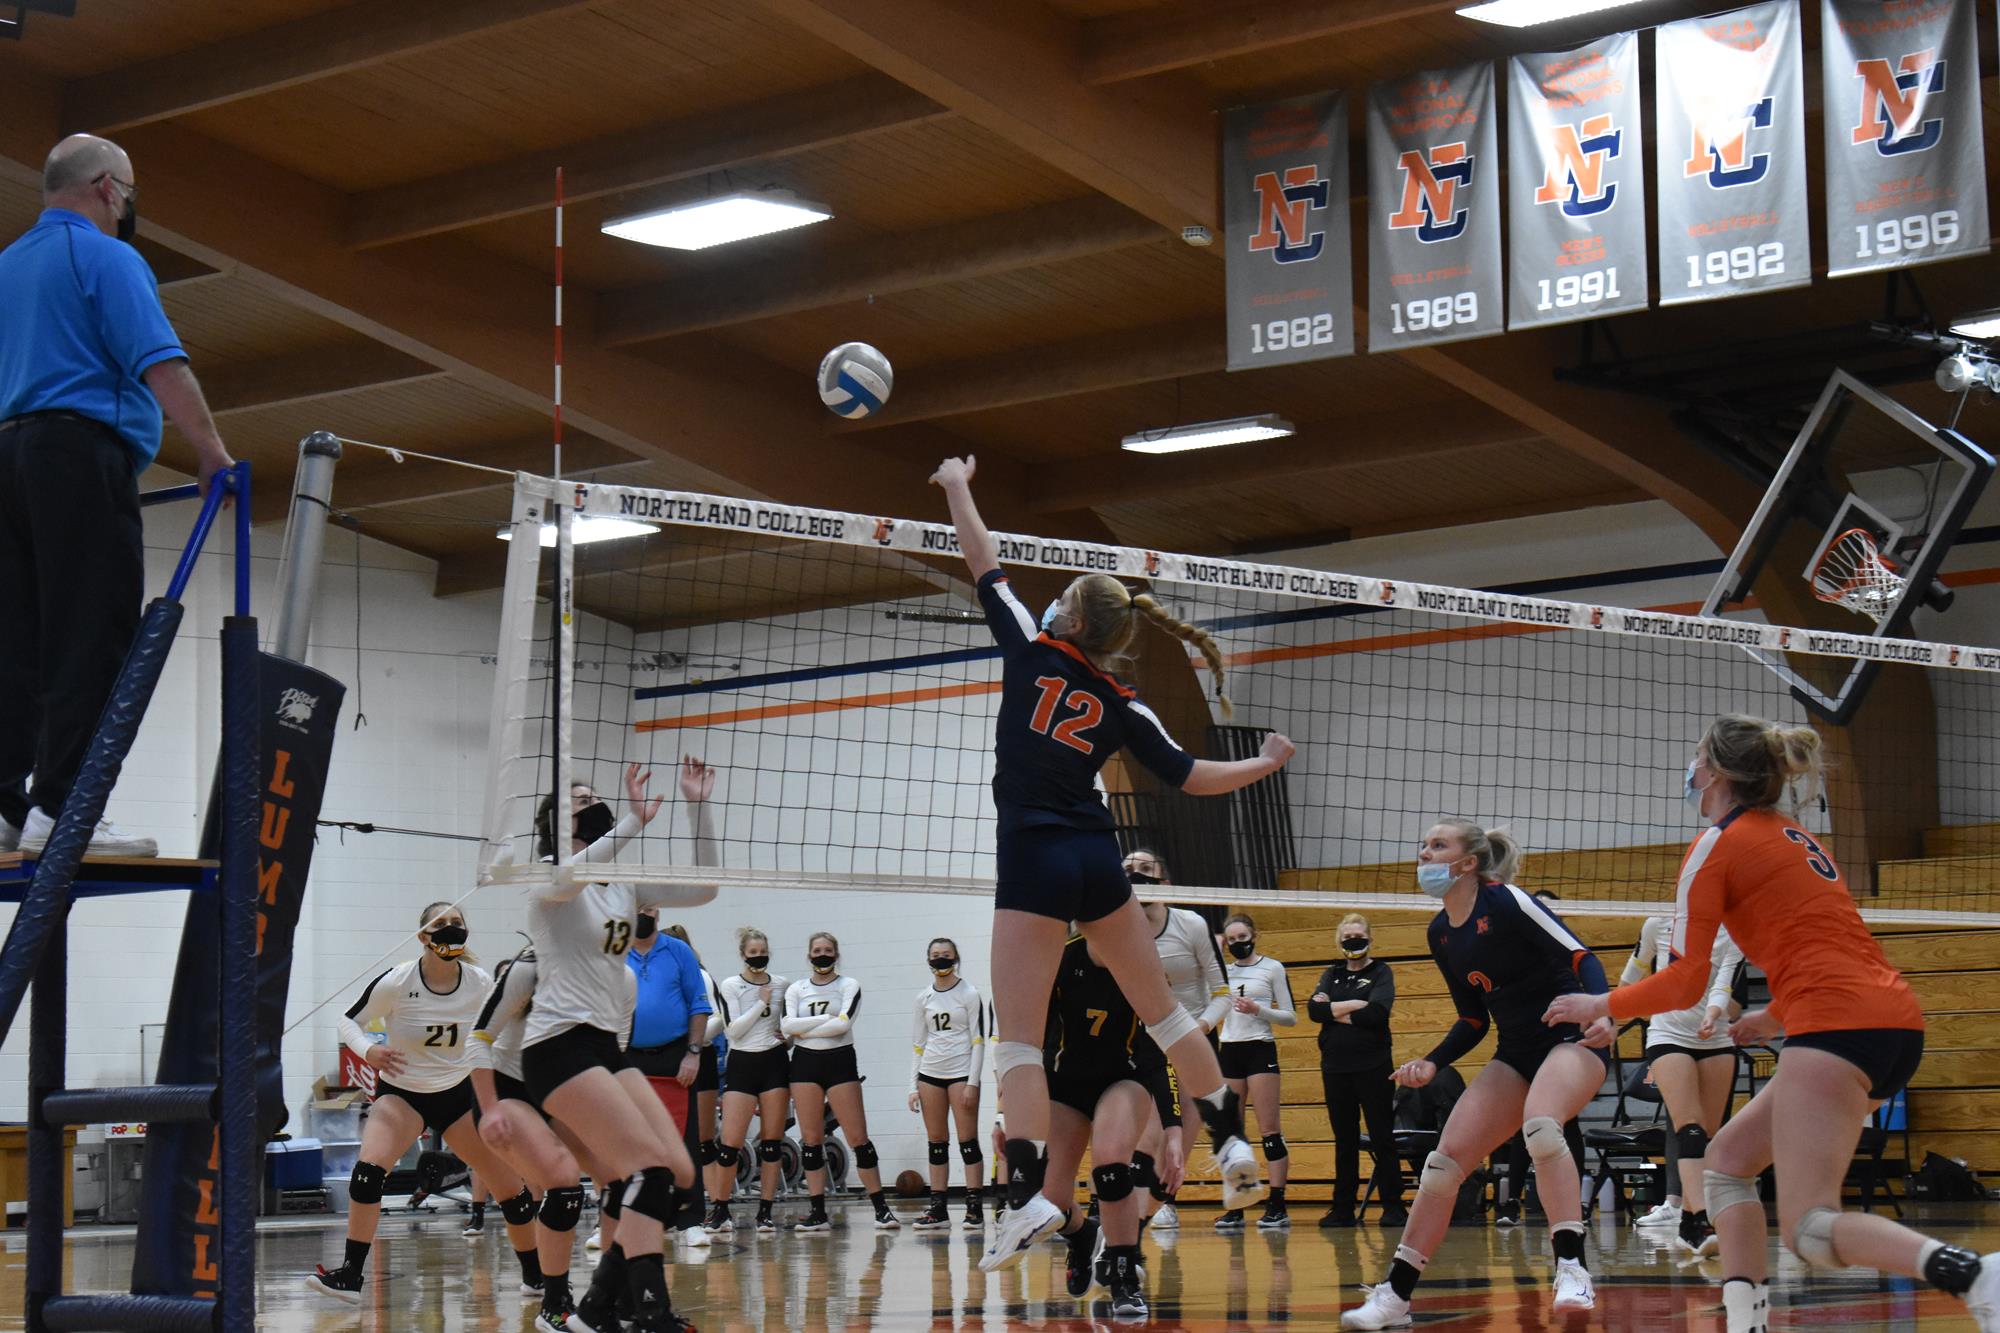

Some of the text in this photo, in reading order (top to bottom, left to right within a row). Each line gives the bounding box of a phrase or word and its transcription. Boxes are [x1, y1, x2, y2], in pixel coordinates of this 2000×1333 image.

[1851, 47, 1947, 157] NC
[1534, 112, 1624, 218] NC
[1248, 164, 1330, 265] NC
[1388, 141, 1475, 244] NC
[1855, 209, 1959, 259] 1996
[1687, 241, 1785, 288] 1992
[1391, 291, 1478, 334] 1989
[1537, 267, 1621, 311] 1991
[1251, 313, 1334, 354] 1982
[620, 494, 751, 527] NORTHLAND
[756, 510, 844, 539] COLLEGE
[922, 529, 1037, 562] NORAND
[1041, 545, 1118, 571] COLLEGE
[1186, 562, 1284, 590] NORTHLAND
[1290, 575, 1358, 600] COLLEGE
[1417, 591, 1506, 618] NORTHLAND
[1510, 603, 1571, 625] COLLEGE
[1624, 615, 1704, 639] NORTHLAND
[1707, 625, 1761, 645] COLLEGE
[1809, 636, 1880, 658] NORTHLAND
[1884, 643, 1933, 663] COLLEGE
[1029, 675, 1103, 755] 12
[1783, 827, 1838, 882] 3
[603, 919, 631, 955] 13
[807, 1001, 830, 1017] 17
[932, 1012, 952, 1031] 12
[1086, 1008, 1108, 1037] 7
[424, 1023, 459, 1048] 21
